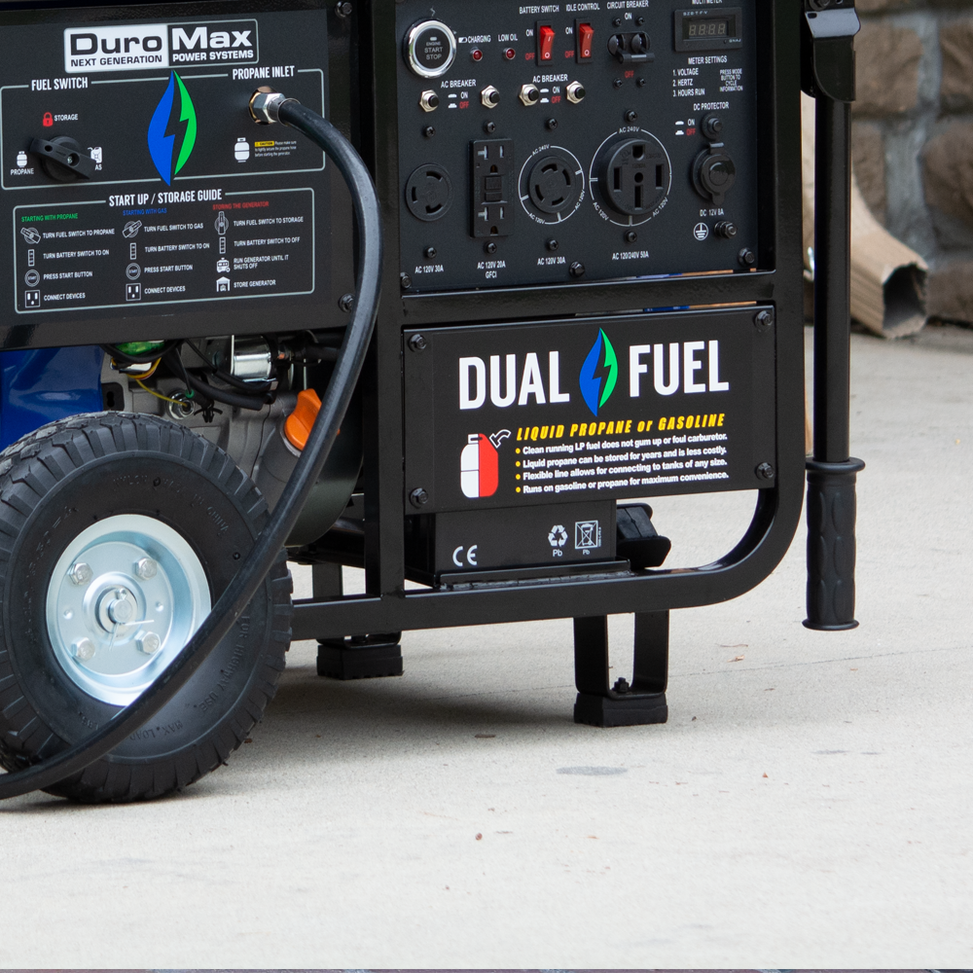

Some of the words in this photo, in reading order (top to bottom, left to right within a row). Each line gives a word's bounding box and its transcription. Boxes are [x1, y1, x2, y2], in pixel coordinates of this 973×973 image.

[519, 6, 540, 14] BATTERY
[541, 5, 559, 13] SWITCH
[577, 3, 600, 11] CONTROL
[607, 1, 625, 9] CIRCUIT
[626, 0, 649, 8] BREAKER
[71, 58, 96, 67] NEXT
[100, 55, 162, 66] GENERATION
[173, 52, 207, 62] POWER
[210, 50, 253, 60] SYSTEMS
[688, 57, 704, 65] METER
[705, 55, 727, 64] SETTINGS
[232, 67, 270, 80] PROPANE
[272, 65, 294, 77] INLET
[542, 74, 568, 82] BREAKER
[677, 68, 699, 76] VOLTAGE
[32, 79, 52, 91] FUEL
[54, 77, 88, 90] SWITCH
[450, 79, 476, 88] BREAKER
[678, 78, 693, 86] HERTZ
[701, 102, 729, 110] PROTECTOR
[109, 194, 135, 207] START
[138, 193, 148, 205] UP
[151, 193, 156, 205] /
[158, 190, 195, 203] STORAGE
[198, 189, 222, 201] GUIDE
[458, 351, 570, 410] DUAL
[629, 339, 729, 397] FUEL
[516, 424, 564, 441] LIQUID
[569, 420, 632, 437] PROPANE
[637, 421, 653, 432] or
[658, 413, 725, 431] GASOLINE
[522, 446, 544, 454] Clean
[546, 444, 574, 453] running
[575, 442, 585, 451] LP
[586, 441, 600, 450] fuel
[601, 440, 619, 448] does
[621, 439, 634, 447] not
[634, 439, 651, 448] gum
[652, 438, 662, 446] up
[672, 434, 686, 443] foul
[687, 433, 728, 442] carburetor.
[522, 458, 545, 469] Liquid
[547, 457, 577, 468] propane
[594, 455, 604, 463] be
[605, 452, 628, 462] stored
[630, 452, 640, 460] for
[641, 451, 662, 461] years
[663, 449, 677, 457] and
[678, 448, 685, 456] is
[686, 448, 701, 456] less
[703, 446, 727, 455] costly.
[523, 471, 553, 480] Flexible
[554, 470, 568, 478] line
[570, 468, 595, 477] allows
[608, 463, 651, 474] connecting
[662, 461, 683, 470] tanks
[685, 460, 693, 468] of
[694, 460, 708, 468] any
[710, 458, 727, 466] size.
[523, 485, 542, 493] Runs
[555, 481, 587, 493] gasoline
[597, 479, 628, 490] propane
[629, 477, 640, 485] for
[641, 475, 678, 484] maximum
[680, 471, 729, 481] convenience.
[552, 549, 563, 557] Pb
